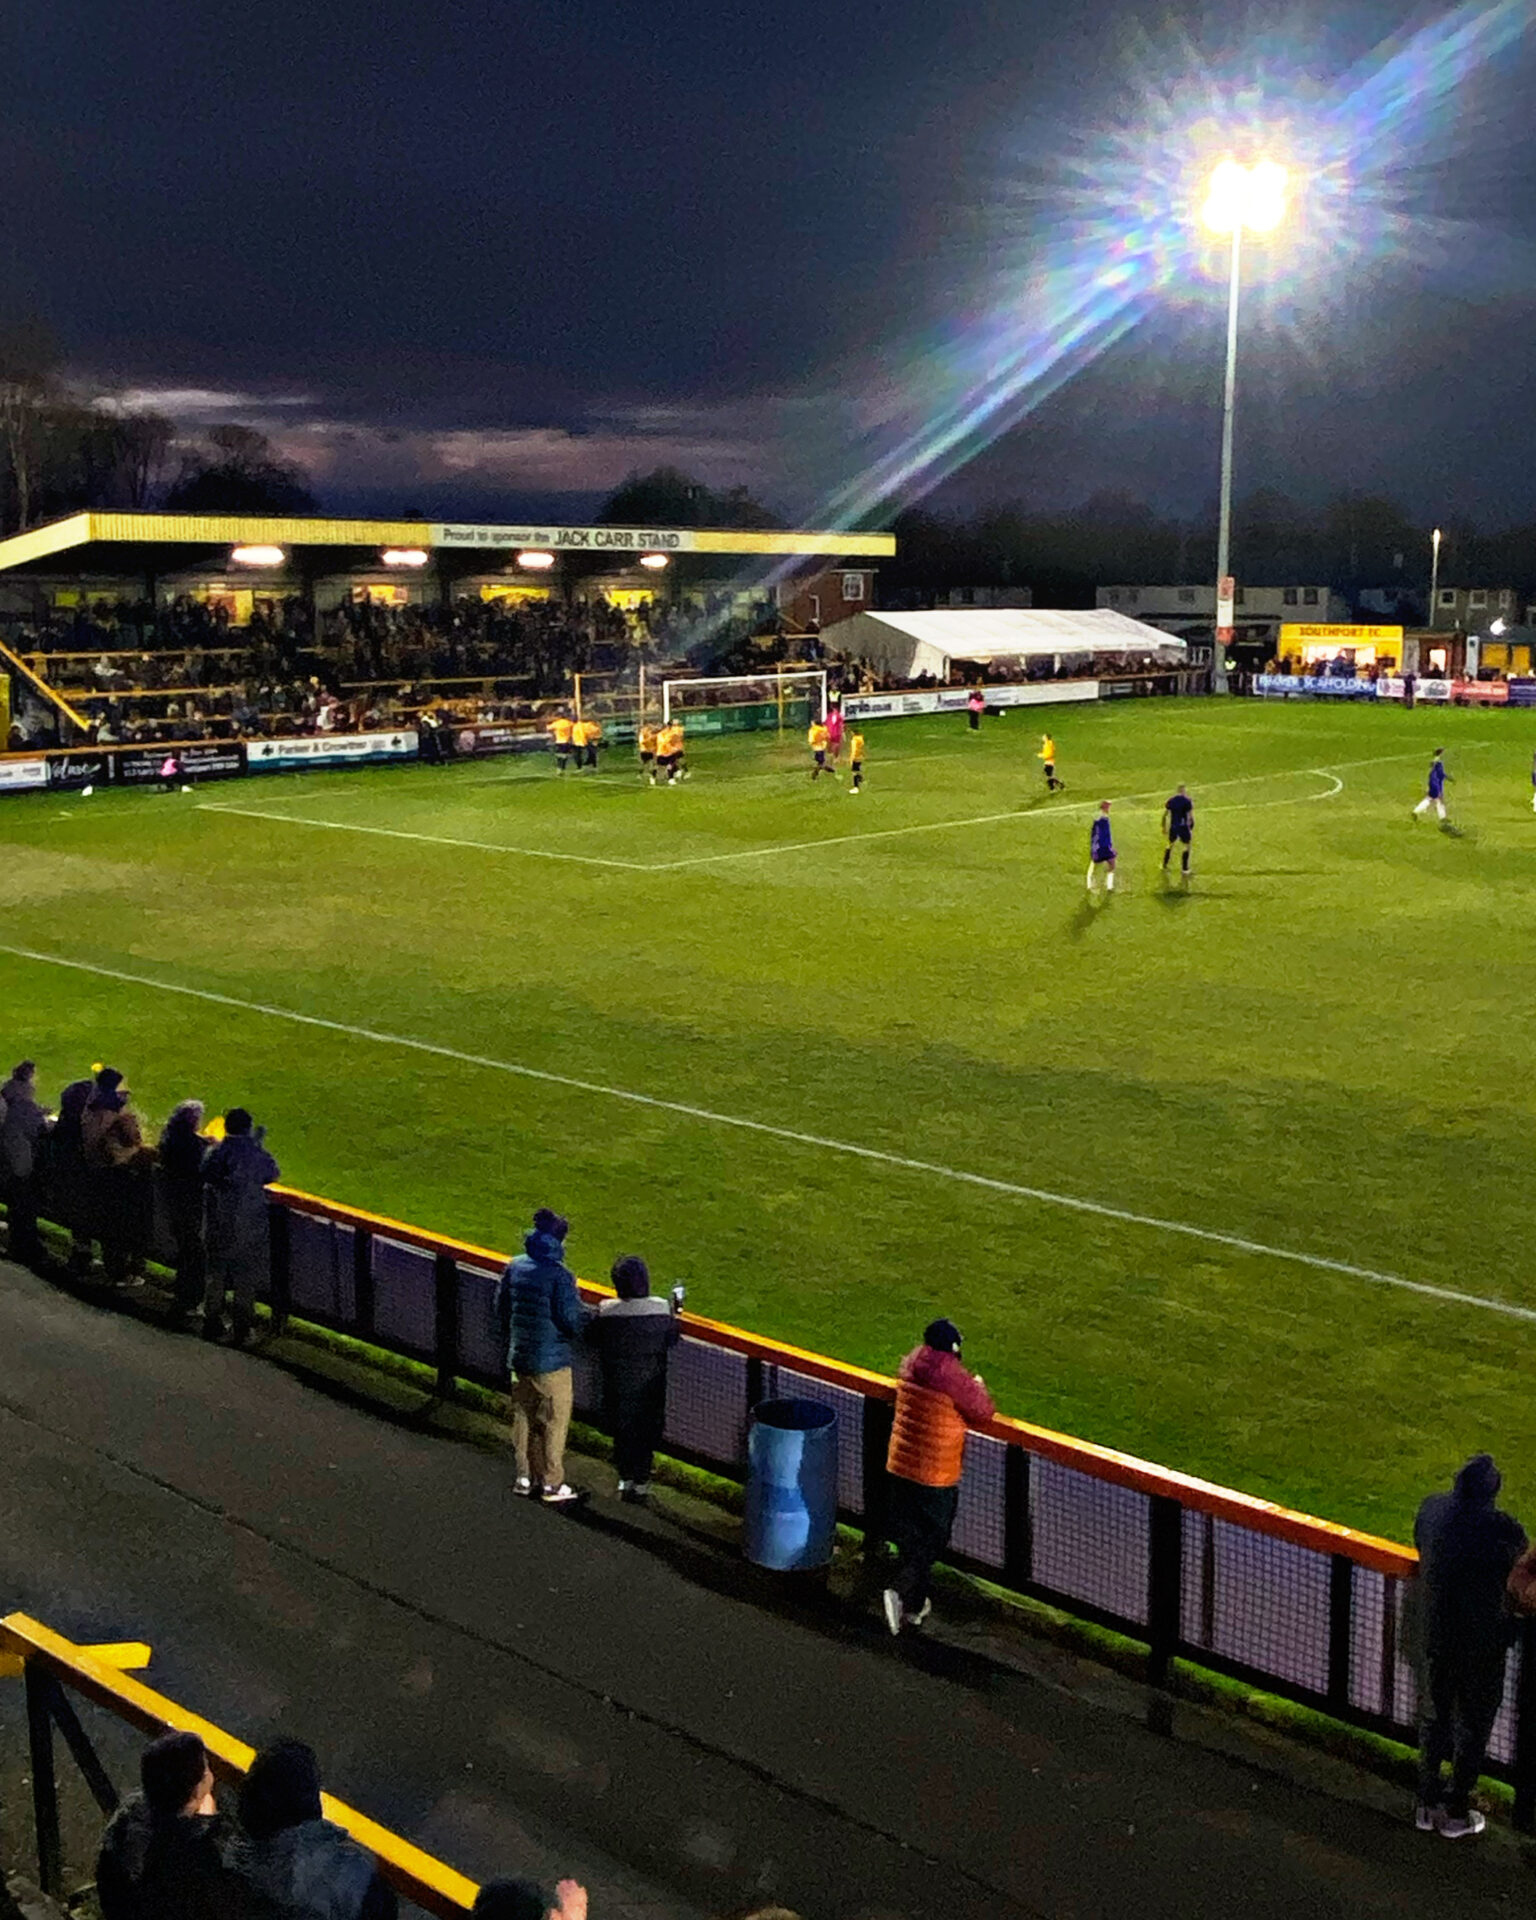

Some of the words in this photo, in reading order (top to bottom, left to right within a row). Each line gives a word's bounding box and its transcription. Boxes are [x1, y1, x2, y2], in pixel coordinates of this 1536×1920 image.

[443, 527, 474, 540] Proud
[553, 529, 591, 546] JACK
[594, 530, 634, 547] CARR
[637, 532, 680, 548] STAND
[1299, 626, 1364, 637] SOUTHPORT
